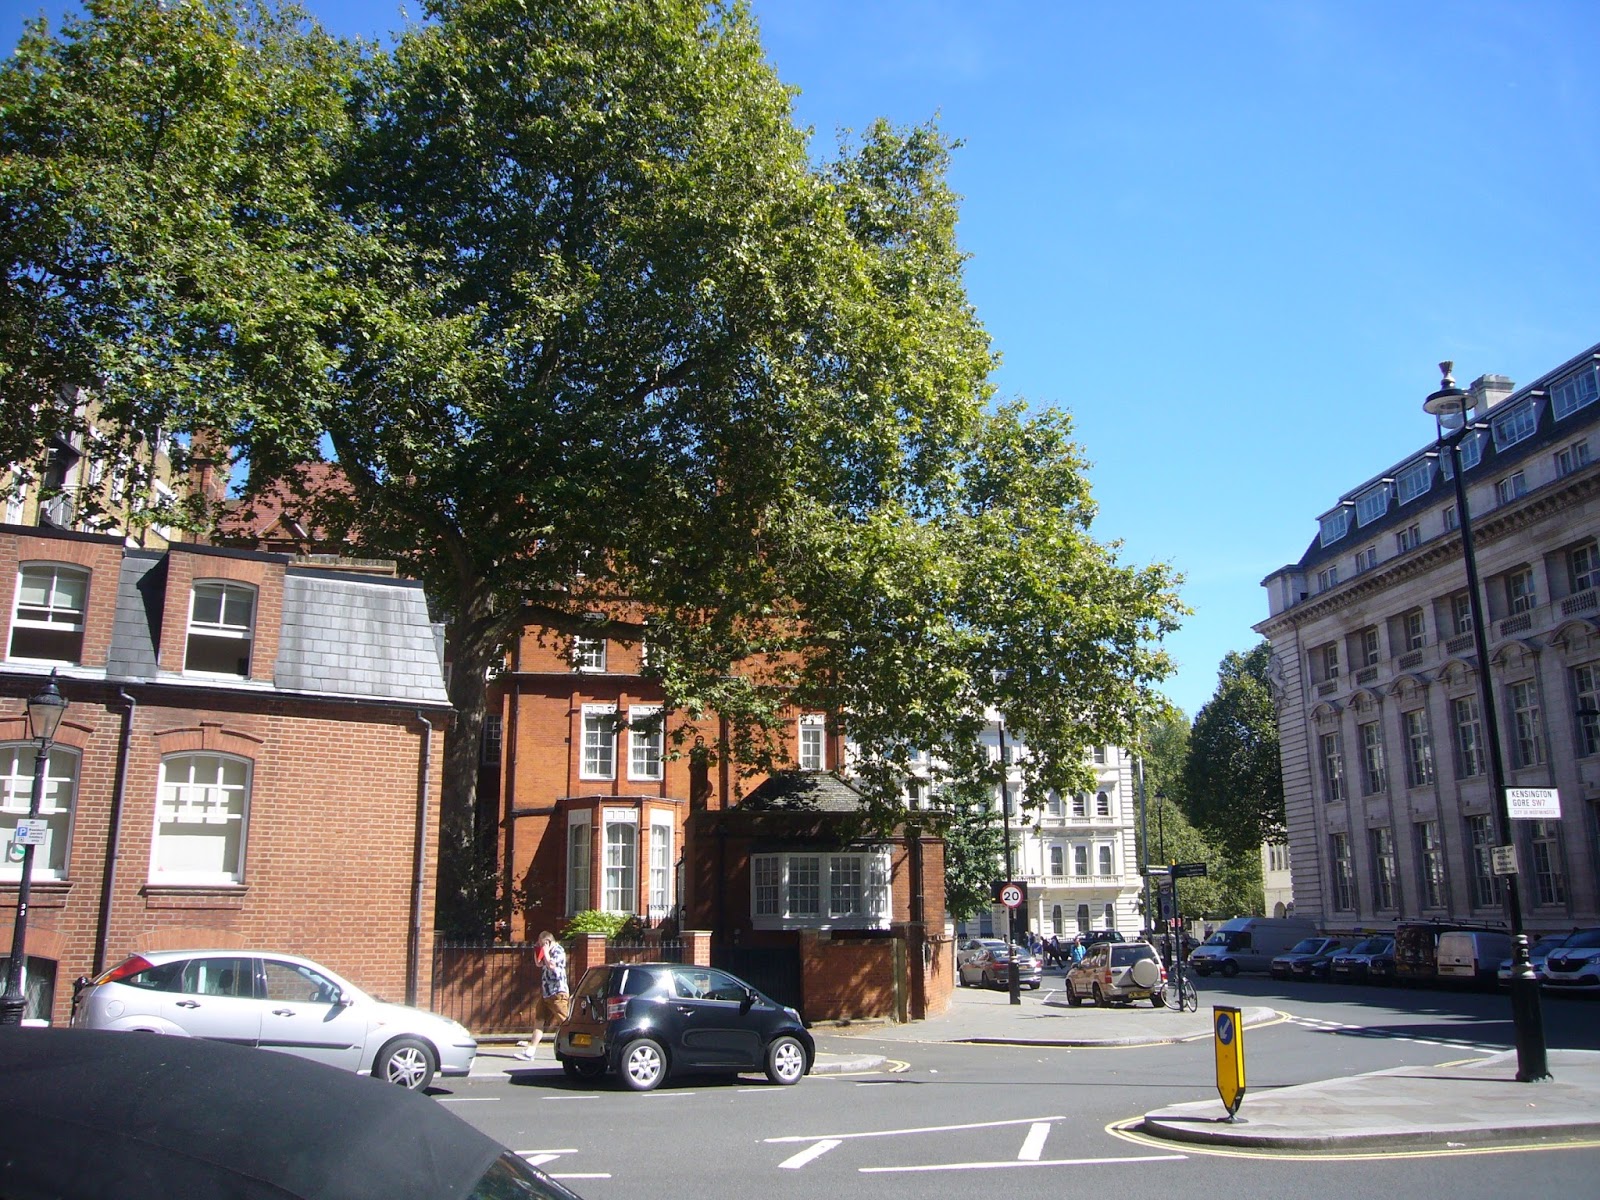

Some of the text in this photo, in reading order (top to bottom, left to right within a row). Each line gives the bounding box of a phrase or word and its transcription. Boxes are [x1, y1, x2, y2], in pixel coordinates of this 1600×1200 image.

[1511, 790, 1552, 798] KENSINGTON
[1512, 799, 1546, 807] GORE SW7
[19, 827, 27, 836] P
[1003, 891, 1020, 901] 20
